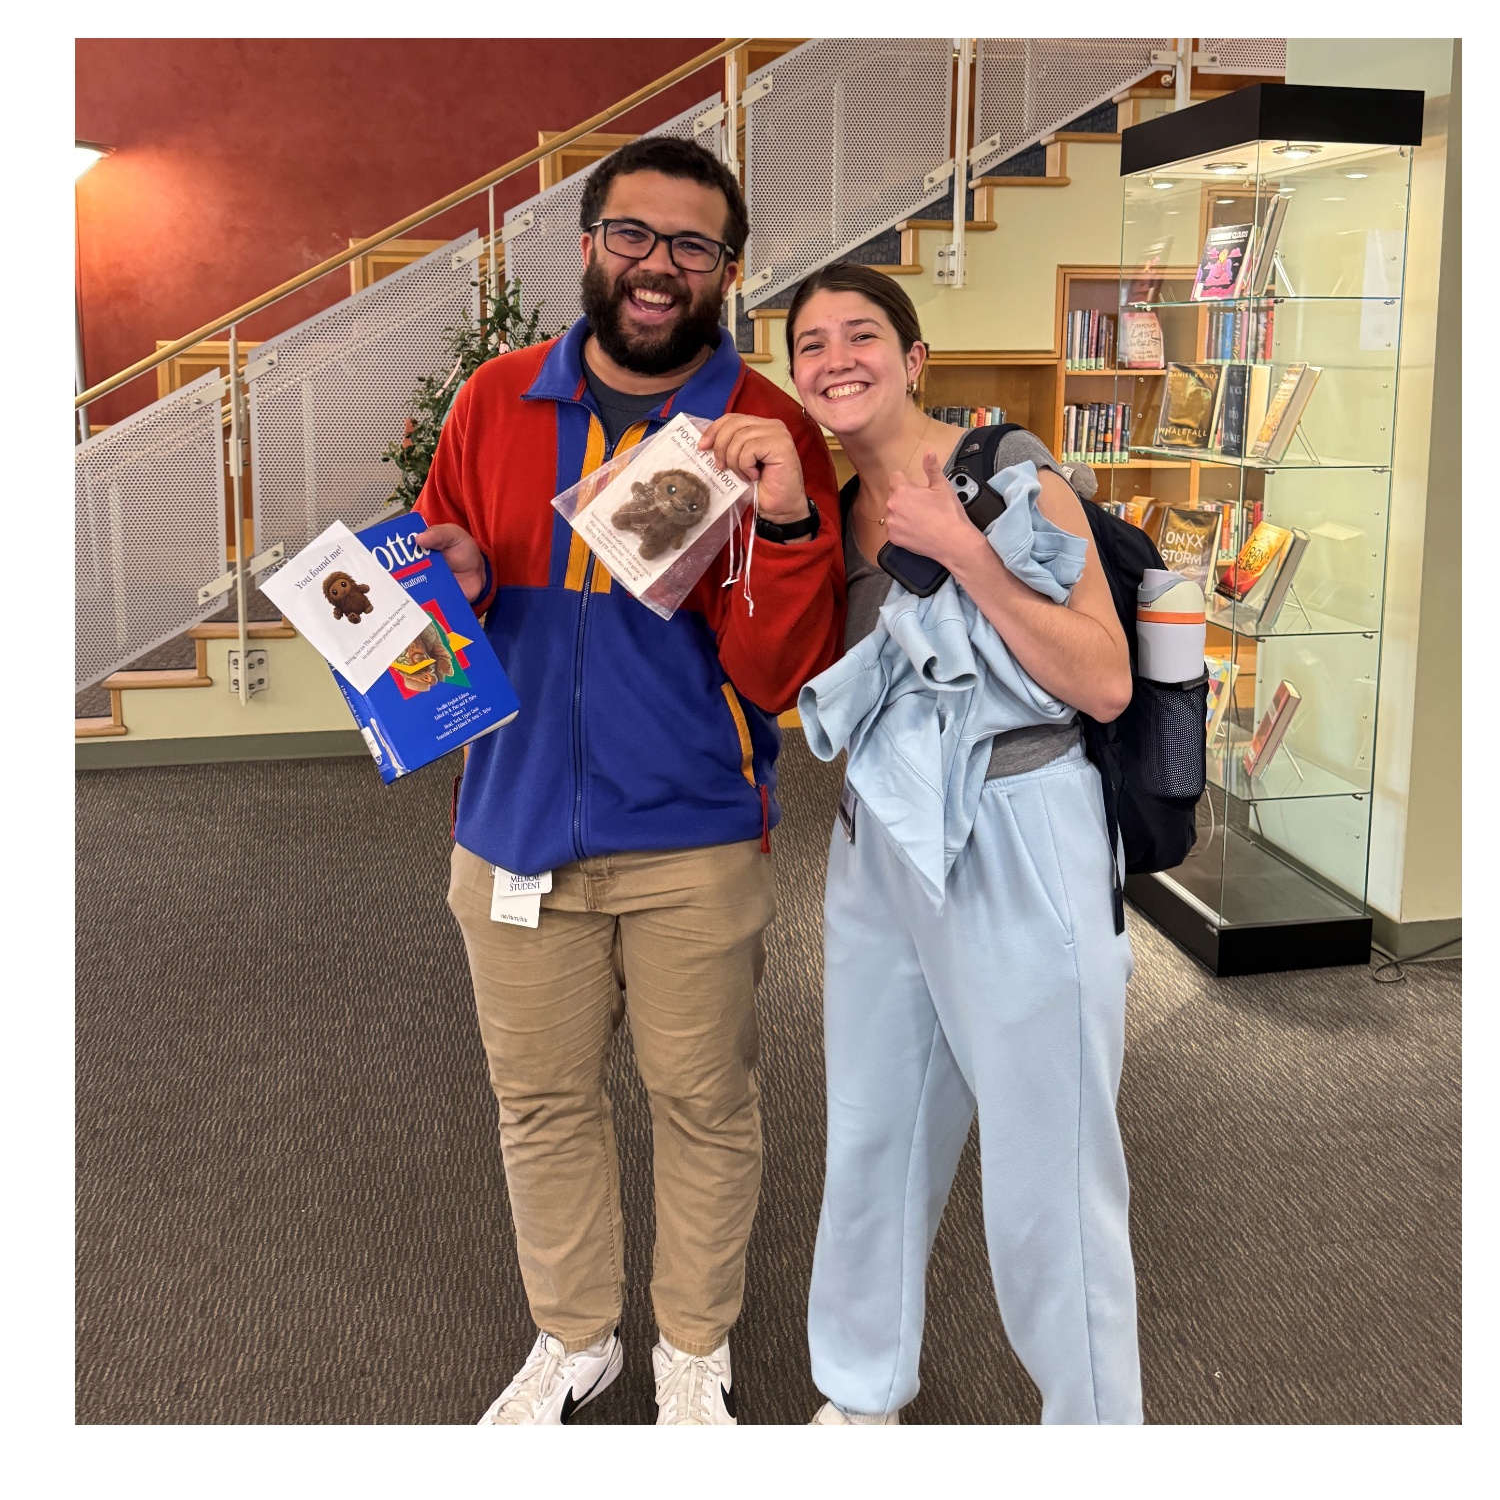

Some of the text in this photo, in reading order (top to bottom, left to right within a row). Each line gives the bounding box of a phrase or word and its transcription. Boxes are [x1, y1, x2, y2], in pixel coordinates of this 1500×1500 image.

[1129, 322, 1157, 330] FAMOUS
[1130, 329, 1158, 339] LAST
[1129, 340, 1158, 348] WORDS
[1168, 371, 1219, 380] DANIEL KRAUS
[1158, 427, 1208, 439] WHALEFALL
[1165, 531, 1205, 549] ONYX
[1161, 549, 1202, 566] STORM
[294, 545, 344, 590] You found me!
[510, 874, 541, 883] MEDICAL
[510, 882, 541, 891] STUDENT
